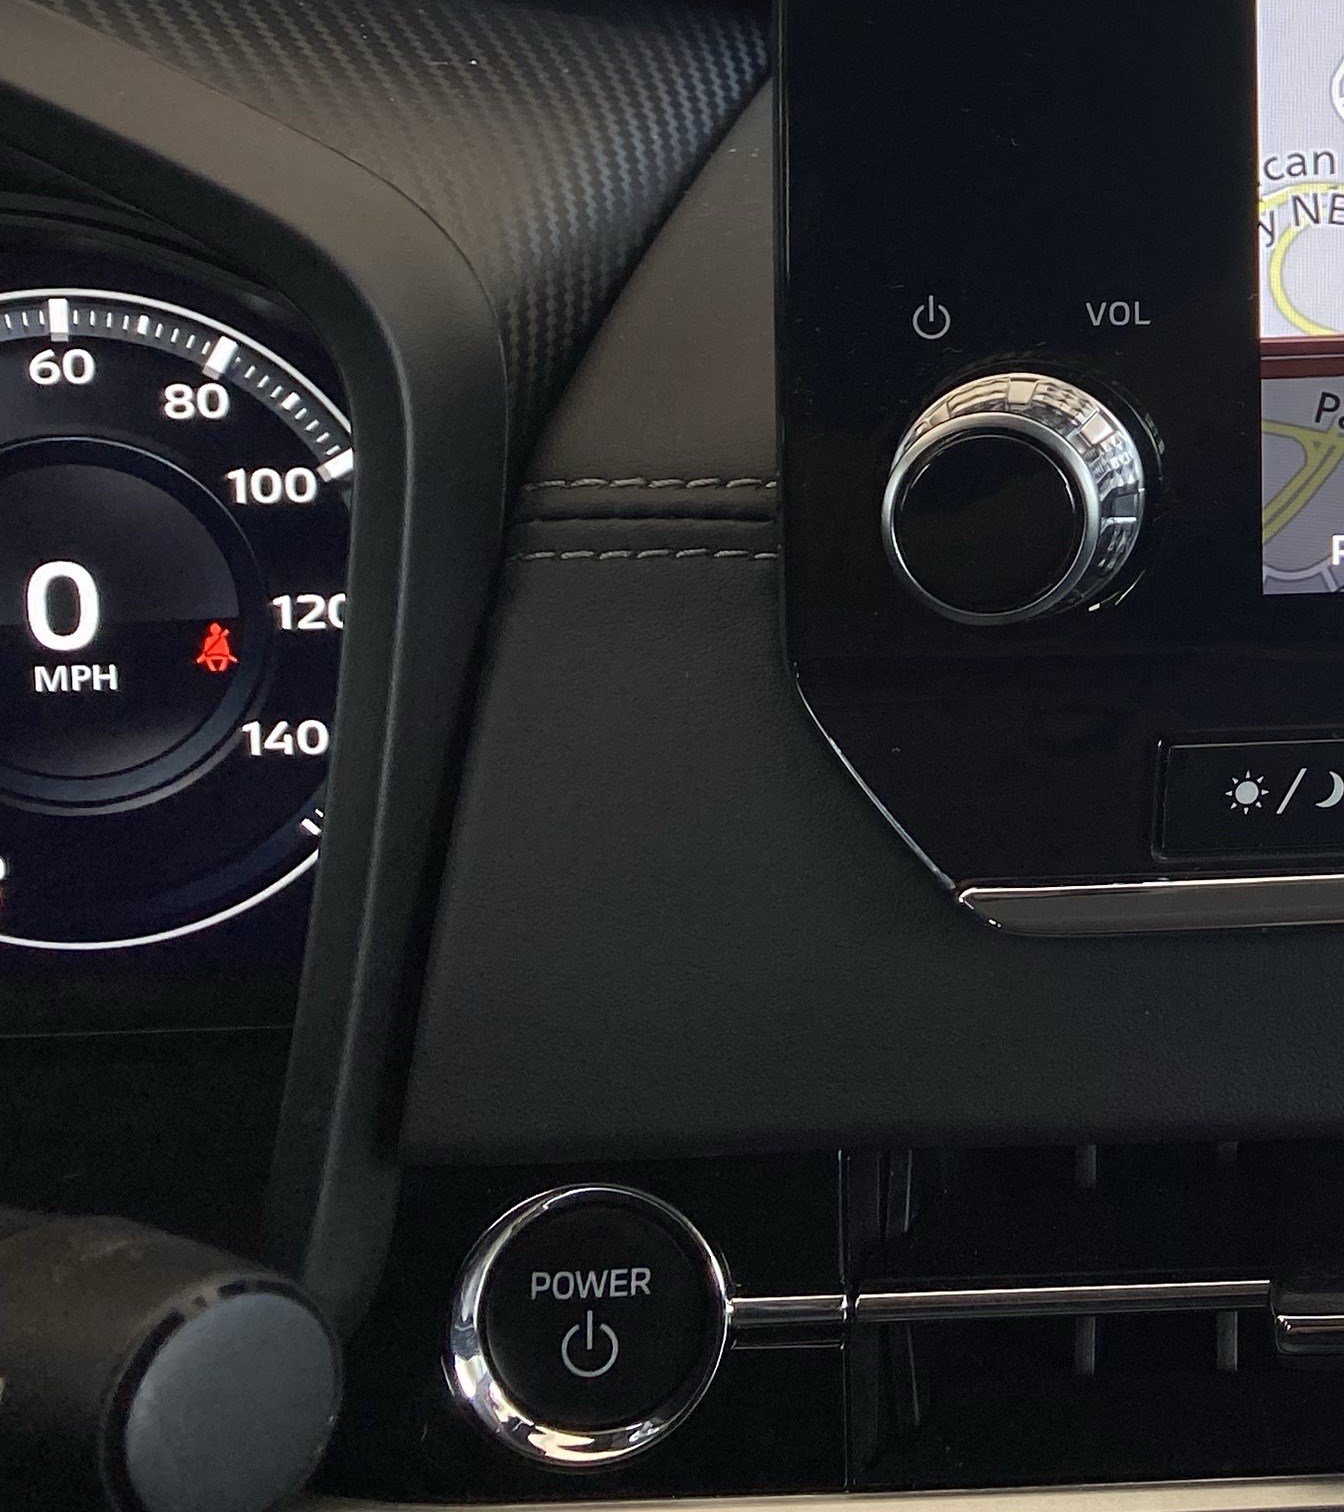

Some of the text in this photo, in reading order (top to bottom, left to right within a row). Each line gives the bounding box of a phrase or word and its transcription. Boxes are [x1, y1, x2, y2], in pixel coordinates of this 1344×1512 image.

[1263, 150, 1337, 181] can
[1085, 300, 1152, 327] VOL
[28, 347, 95, 386] 60
[163, 383, 230, 422] 80
[226, 466, 318, 506] 100
[24, 560, 101, 653] 0
[34, 663, 119, 693] MPH
[241, 718, 331, 757] 140
[529, 1266, 653, 1301] POWER
